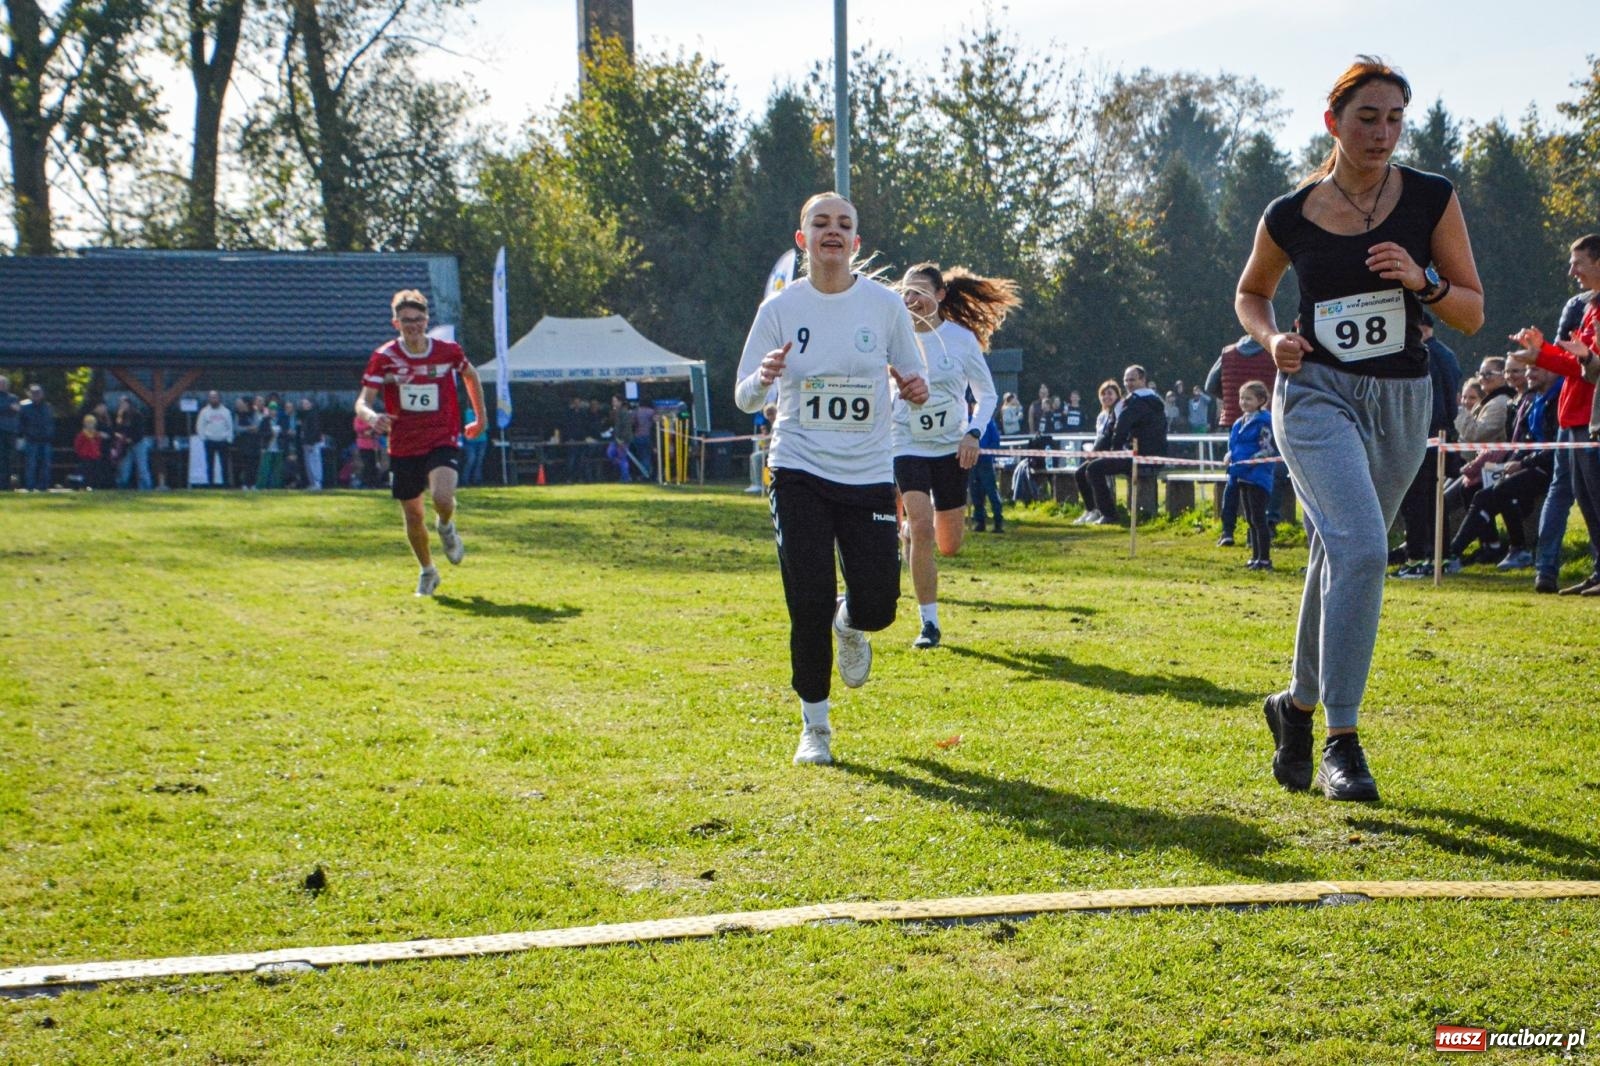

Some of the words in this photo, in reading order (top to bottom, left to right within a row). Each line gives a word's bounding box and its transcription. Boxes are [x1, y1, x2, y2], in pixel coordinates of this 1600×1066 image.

[797, 327, 810, 354] 9
[1335, 316, 1388, 350] 98
[408, 394, 430, 406] 76
[806, 395, 870, 421] 109
[919, 410, 947, 431] 97
